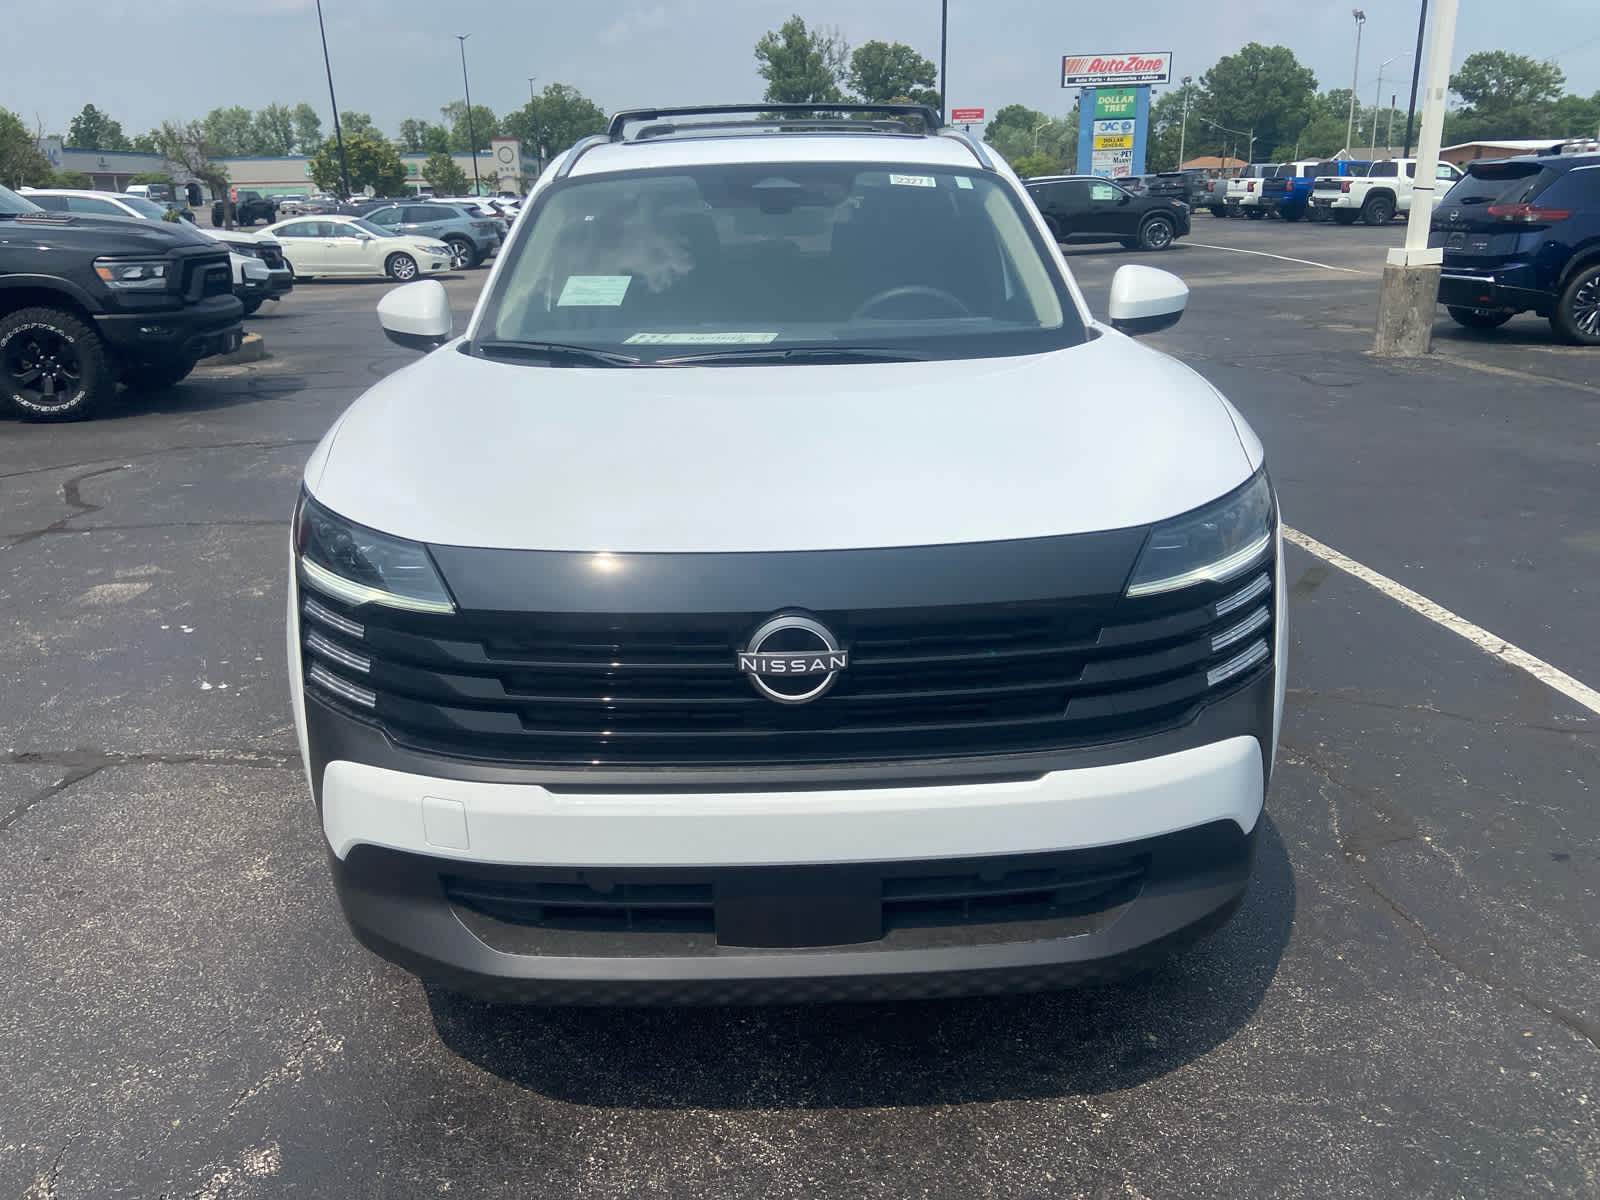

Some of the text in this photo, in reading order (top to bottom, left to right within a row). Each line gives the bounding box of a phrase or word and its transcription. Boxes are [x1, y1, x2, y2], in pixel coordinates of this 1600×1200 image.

[1087, 56, 1163, 73] AutoZone
[1097, 95, 1135, 104] DOLLAR
[1104, 104, 1127, 112] TREE
[740, 654, 847, 673] NISSAN
